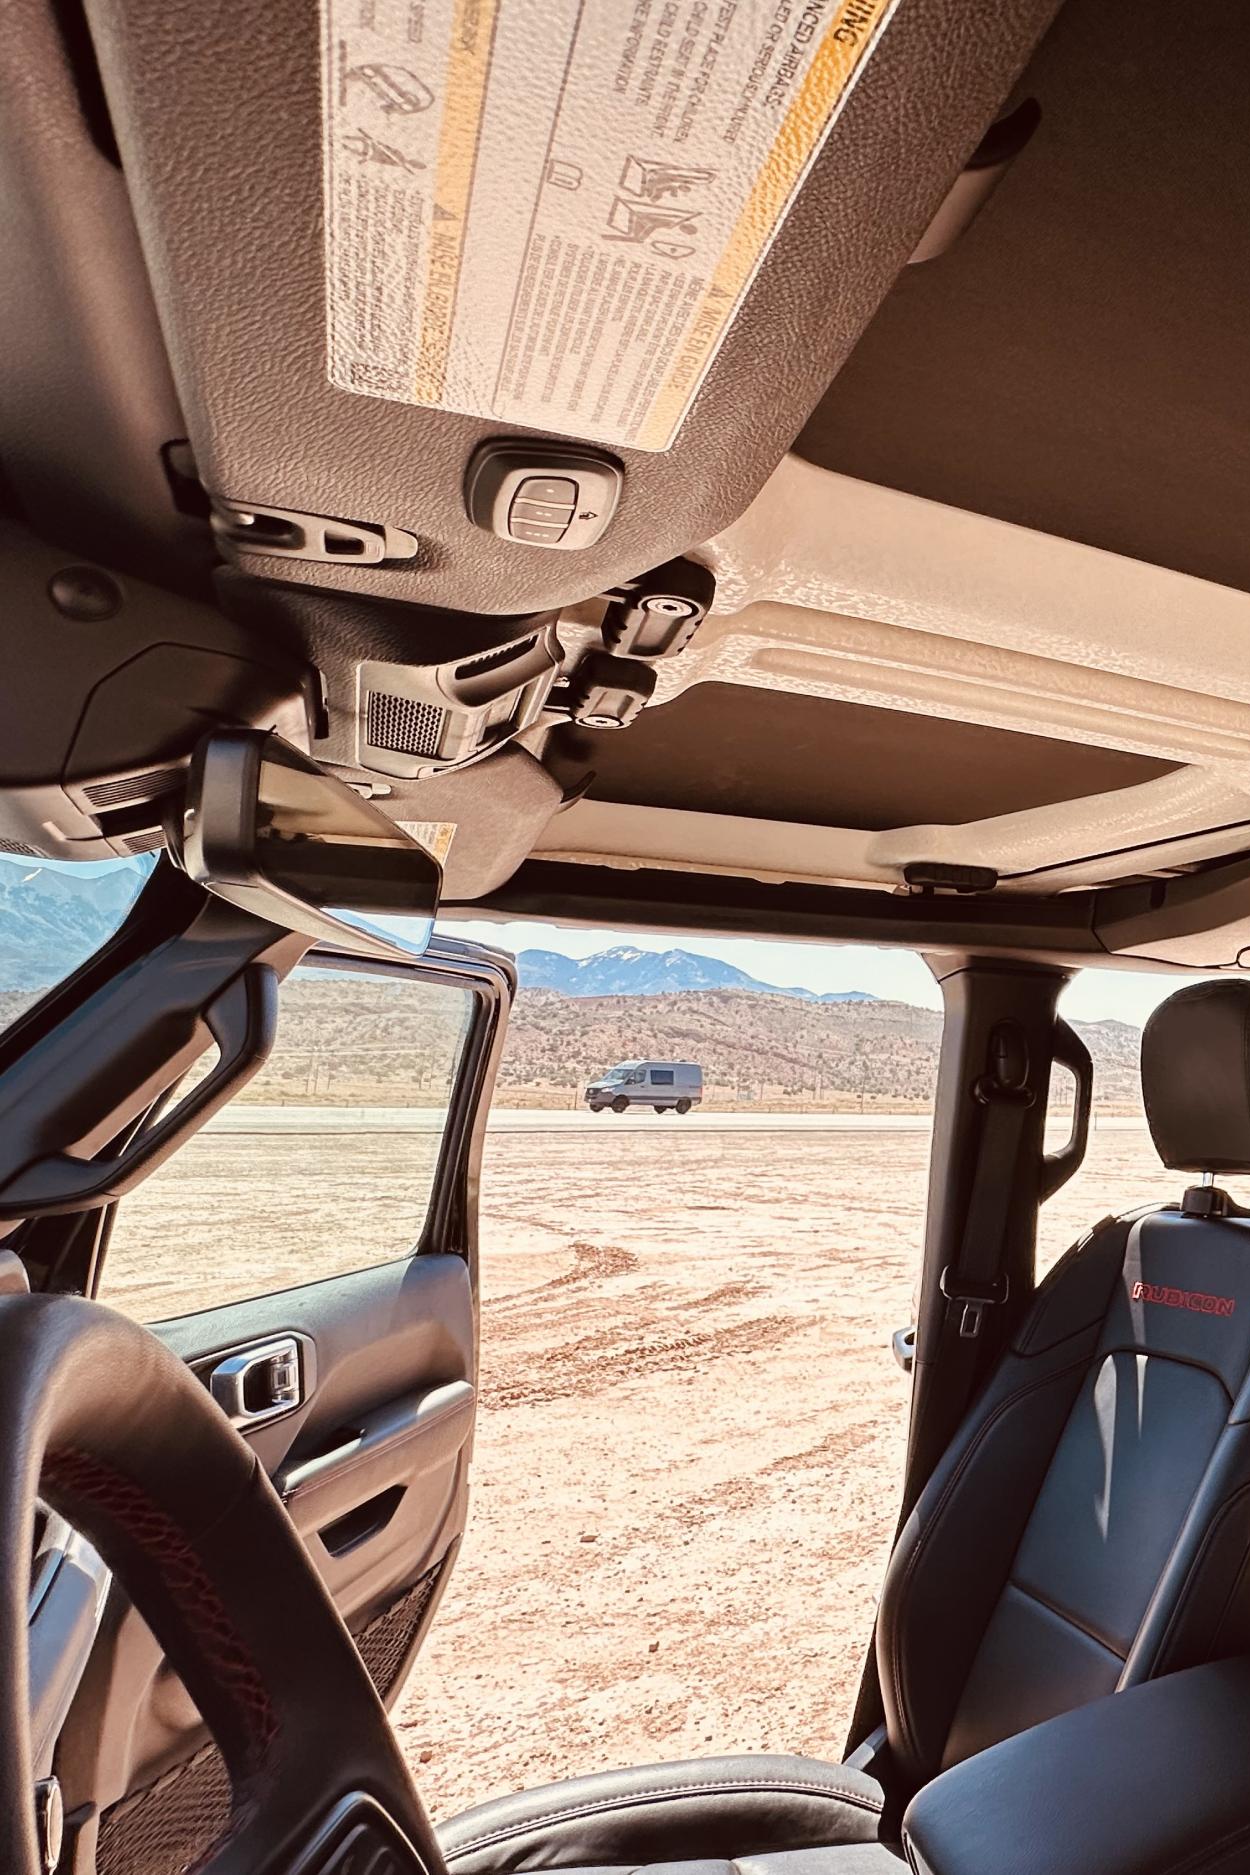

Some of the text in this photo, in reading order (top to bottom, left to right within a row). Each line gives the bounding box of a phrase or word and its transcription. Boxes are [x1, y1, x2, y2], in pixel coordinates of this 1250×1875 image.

[791, 0, 825, 43] NCED
[699, 31, 725, 70] PLACE
[667, 305, 722, 392] MISE EN GARDE
[1132, 1281, 1237, 1316] RUBICON
